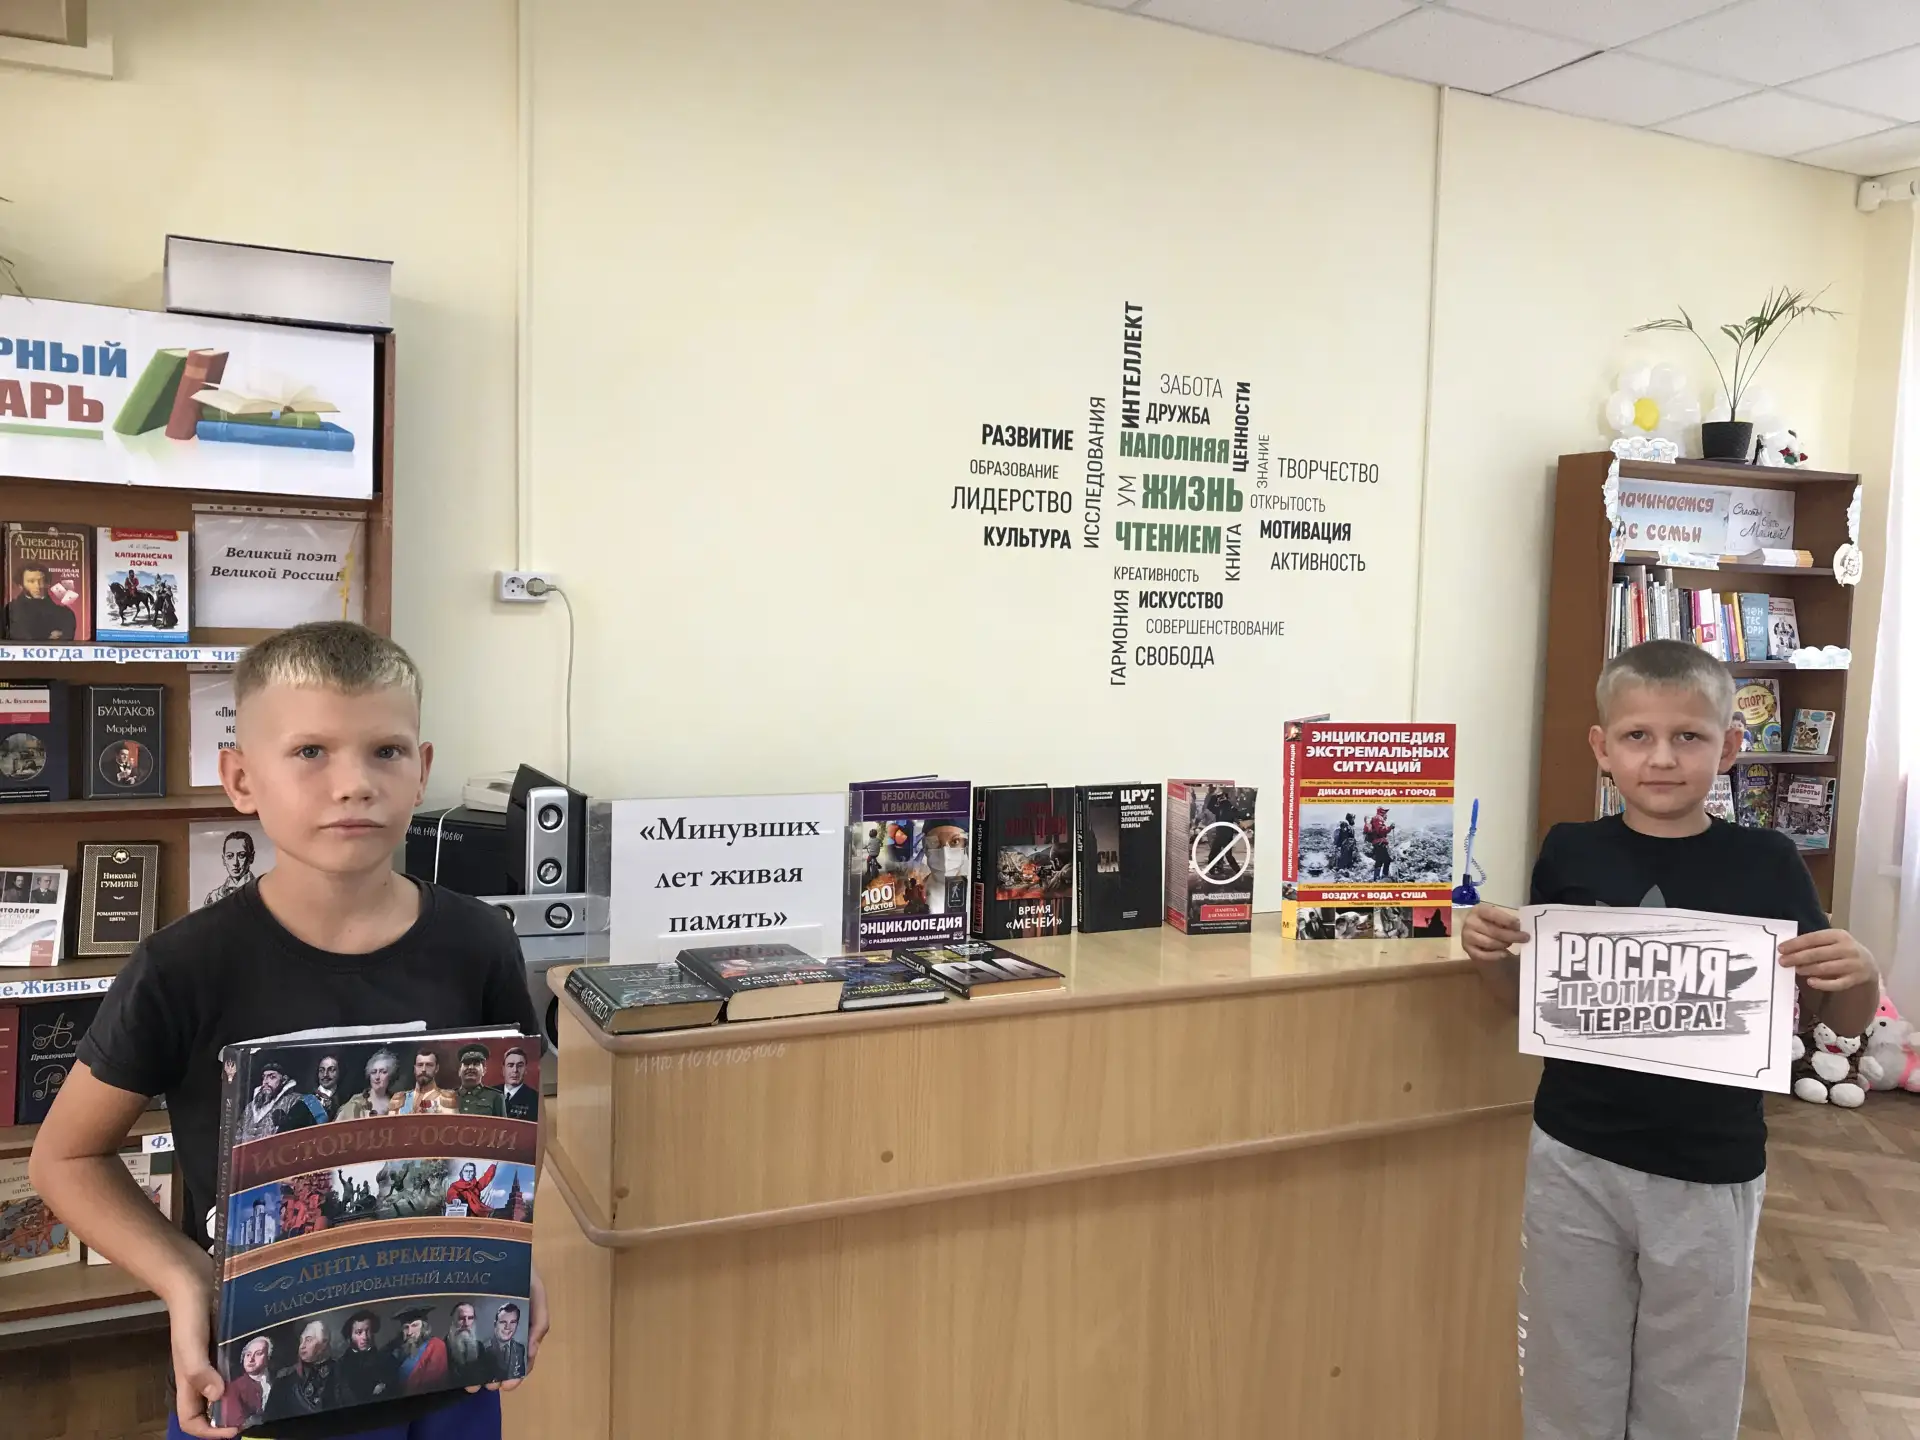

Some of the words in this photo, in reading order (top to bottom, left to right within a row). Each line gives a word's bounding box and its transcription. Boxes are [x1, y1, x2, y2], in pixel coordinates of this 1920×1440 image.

[1121, 301, 1143, 429] ИНТЕЛЛЕКТ
[1160, 373, 1223, 399] ЗАБОТА
[1146, 402, 1210, 425] ДРУЖБА
[981, 423, 1074, 451] РАЗВИТИЕ
[1232, 381, 1251, 473] ЦЕННОСТИ
[1119, 431, 1230, 464] НАПОЛНЯЯ
[969, 459, 1059, 480] ОБРАЗОВАНИЕ
[1256, 433, 1270, 489] ЗНАНИЕ
[1277, 457, 1379, 484] ТВОРЧЕСТВО
[1083, 396, 1106, 548] ИССЛЕДОВАНИЯ
[951, 486, 1072, 515] ЛИДЕРСТВО
[1117, 475, 1137, 507] УМ
[1142, 473, 1244, 513] ЖИЗНЬ
[1250, 494, 1326, 513] ОТКРЫТОСТЬ
[15, 533, 78, 548] Александр
[983, 526, 1071, 550] КУЛЬТУРА
[1115, 521, 1221, 555] ЧТЕНИЕМ
[1259, 519, 1352, 544] МОТИВАЦИЯ
[1646, 523, 1701, 543] семьи
[20, 548, 78, 561] ПУШКИН
[115, 551, 173, 560] КАПИТАНСКАЯ
[225, 546, 292, 563] Великий
[296, 551, 337, 565] поэт
[1225, 523, 1242, 581] КНИГА
[1270, 551, 1366, 573] АКТИВНОСТЬ
[210, 565, 277, 580] Великой
[281, 567, 341, 583] России!
[1113, 566, 1199, 583] КРЕАТИВНОСТЬ
[1138, 591, 1223, 610] ИСКУССТВО
[1110, 590, 1130, 686] ГАРМОНИЯ
[1145, 618, 1285, 637] СОВЕРШЕНСТВОВАНИЕ
[23, 648, 83, 660] когда
[93, 648, 201, 662] перестают
[1135, 645, 1215, 669] СВОБОДА
[97, 706, 155, 717] БУЛГАКОВ
[106, 724, 147, 735] Морфий
[1312, 731, 1446, 745] ЭНЦИКЛОПЕДИЯ
[1306, 746, 1449, 759] ЭКСТРЕМАЛЬНЫХ
[1333, 758, 1421, 775] СИТУАЦИЙ
[881, 791, 950, 800] БЕЗОПАСНОСТЬ
[1120, 788, 1155, 805] ЦРУ:
[1317, 788, 1350, 797] ДИКАЯ
[1352, 788, 1396, 797] ПРИРОДА
[1405, 788, 1436, 796] ГОРОД
[882, 803, 889, 811] И
[890, 801, 949, 811] ВЫЖИВАНИЕ
[639, 816, 820, 846] «Минувших
[654, 868, 703, 889] лет
[709, 866, 803, 887] живая
[862, 885, 893, 906] 100
[1321, 892, 1358, 901] ВОЗДУХ
[1367, 892, 1393, 900] ВОДА
[863, 902, 894, 912] ФАКТОВ
[1018, 904, 1051, 916] ВРЕМЯ
[668, 910, 788, 934] память»
[861, 916, 963, 935] ЭНЦИКЛОПЕДИЯ
[1005, 913, 1063, 930] «МЕЧЕЙ»
[1558, 931, 1731, 999] РОССИЯ
[737, 975, 761, 983] КТО
[783, 970, 828, 978] ДУМАЕТ
[1559, 977, 1680, 1009] ПРОТИВ
[1578, 1002, 1726, 1034] ТЕРРОРА!
[251, 1126, 395, 1175] ИСТОРИЯ
[404, 1125, 519, 1150] РОССИИ
[297, 1253, 370, 1284] ЛЕНТА
[375, 1246, 472, 1267] ВРЕМЕНИ
[263, 1270, 441, 1317] ИЛЛЮСТРИРОВАННЫЙ
[443, 1272, 491, 1285] АТЛАС
